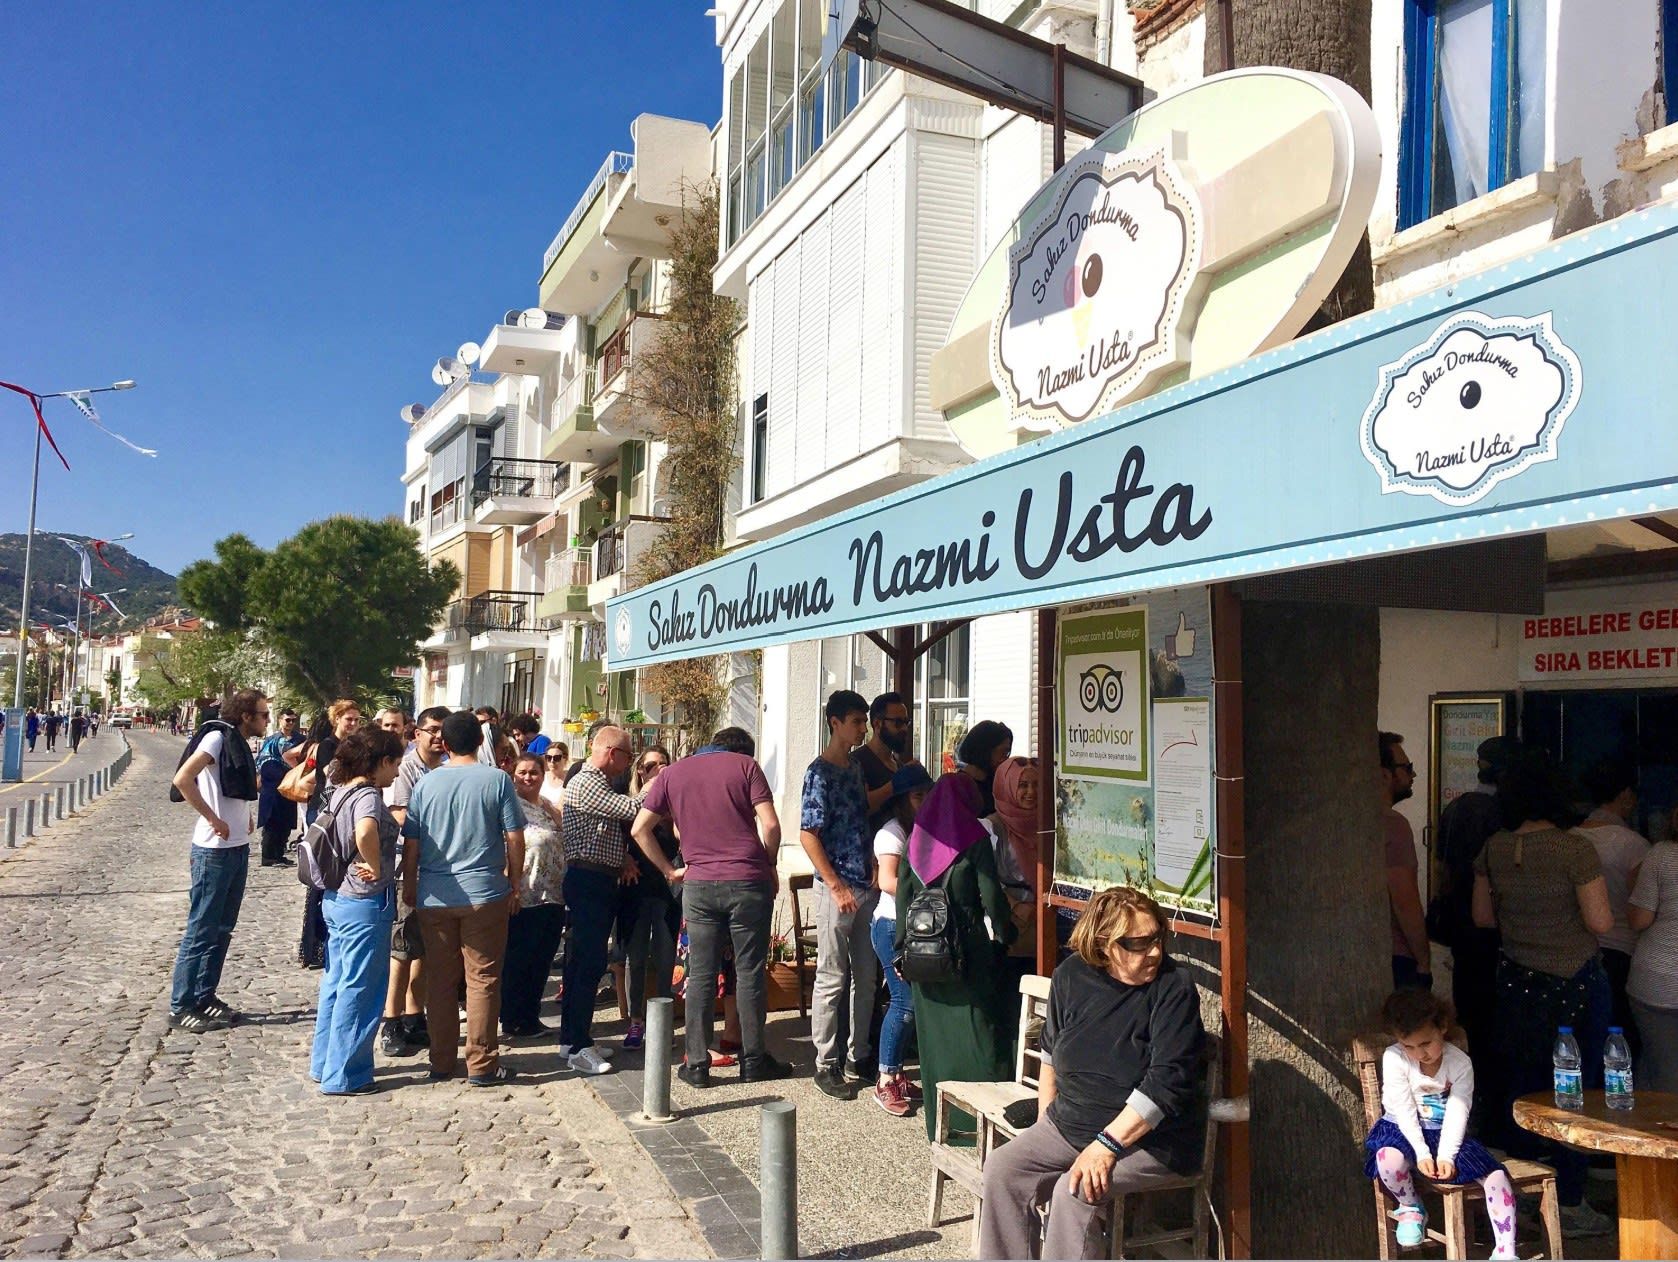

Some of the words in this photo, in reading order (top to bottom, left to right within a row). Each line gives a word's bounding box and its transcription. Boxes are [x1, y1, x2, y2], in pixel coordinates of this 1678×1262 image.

[1066, 191, 1139, 242] Dondurma
[1038, 353, 1085, 400] Nazmi
[1089, 330, 1131, 378] Usta
[1443, 342, 1519, 378] Dondurma
[1415, 445, 1466, 473] Nazmi
[1469, 433, 1513, 463] Usta
[697, 561, 835, 640] Dondurma
[848, 510, 1000, 602] Nazmi
[1014, 445, 1214, 580] Usta
[1524, 612, 1632, 639] BEBELERE
[1534, 652, 1581, 673] SIRA
[1588, 647, 1678, 671] BEKLET
[1069, 723, 1134, 748] tripadvisor
